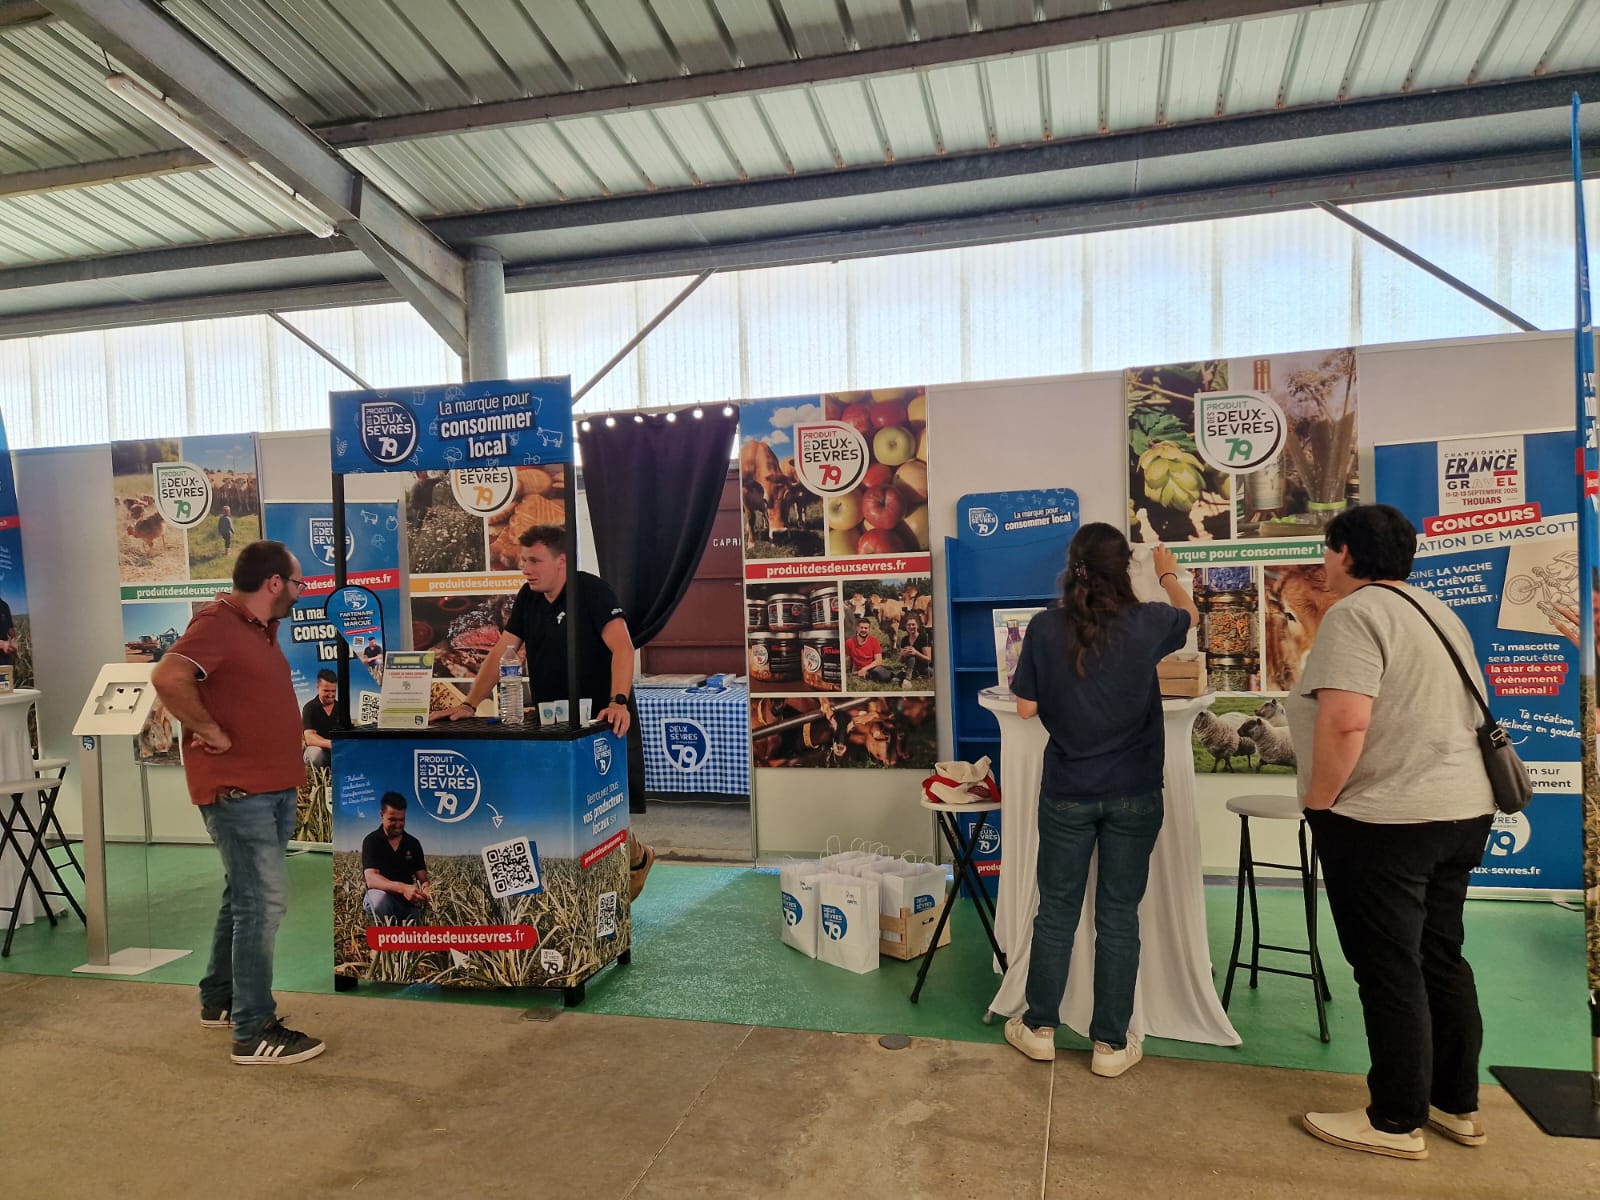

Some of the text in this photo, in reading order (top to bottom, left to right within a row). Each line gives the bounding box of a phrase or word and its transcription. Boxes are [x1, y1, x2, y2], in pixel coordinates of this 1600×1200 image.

[439, 392, 530, 415] La marque pour
[1207, 401, 1248, 410] PRODUIT
[373, 414, 406, 425] DEUX-
[1217, 409, 1266, 423] DEUX-
[366, 424, 412, 436] SEVRES
[441, 411, 532, 438] consommer
[1208, 421, 1274, 436] SEVRES
[378, 437, 398, 456] 79
[468, 433, 507, 458] local
[812, 438, 852, 450] DEUX-
[1225, 438, 1252, 461] 79
[805, 449, 858, 463] SEVRES
[1446, 454, 1517, 474] FRANCE
[168, 477, 199, 488] DEUX-
[460, 473, 508, 484] SEVRES
[819, 464, 841, 486] 79
[162, 487, 204, 498] SEVRES
[473, 486, 494, 506] 79
[1462, 496, 1502, 506] THOUARS
[174, 500, 191, 518] 79
[1022, 509, 1044, 518] marque
[1046, 507, 1059, 516] pour
[1005, 512, 1072, 531] consommer local
[1431, 507, 1535, 533] CONCOURS
[313, 536, 351, 544] SEVS
[1417, 520, 1577, 552] ATION DE MASCOTT
[1210, 548, 1238, 561] pour
[1240, 546, 1314, 558] consommer
[766, 560, 906, 579] produitdesdeuxsevres.fr
[1407, 562, 1493, 580] SINE LA VACHE
[1420, 581, 1435, 589] LA
[1437, 574, 1483, 587] CHÈVRE
[1446, 584, 1488, 596] STYLÉE
[1442, 594, 1493, 607] TEMENT
[292, 608, 304, 621] La
[294, 624, 337, 641] conso
[1491, 643, 1560, 651] Ta mascotte
[1513, 654, 1565, 664] peut-être
[1495, 675, 1558, 684] évènement
[1501, 686, 1546, 695] national
[1519, 708, 1574, 725] Ta création
[1496, 717, 1532, 731] déclinée
[1550, 727, 1582, 738] goodie
[672, 745, 697, 769] 79
[428, 764, 469, 776] DEUX-
[1527, 766, 1538, 775] in
[420, 777, 475, 789] SEVRES
[434, 792, 458, 814] 79
[583, 792, 624, 824] vos producteurs
[592, 817, 609, 836] locaux
[979, 840, 990, 850] 79
[977, 864, 1000, 874] produ
[1469, 866, 1541, 875] ux-sevres.fr
[378, 930, 525, 946] produitdesdeuxsevres.fr
[824, 921, 841, 940] 79
